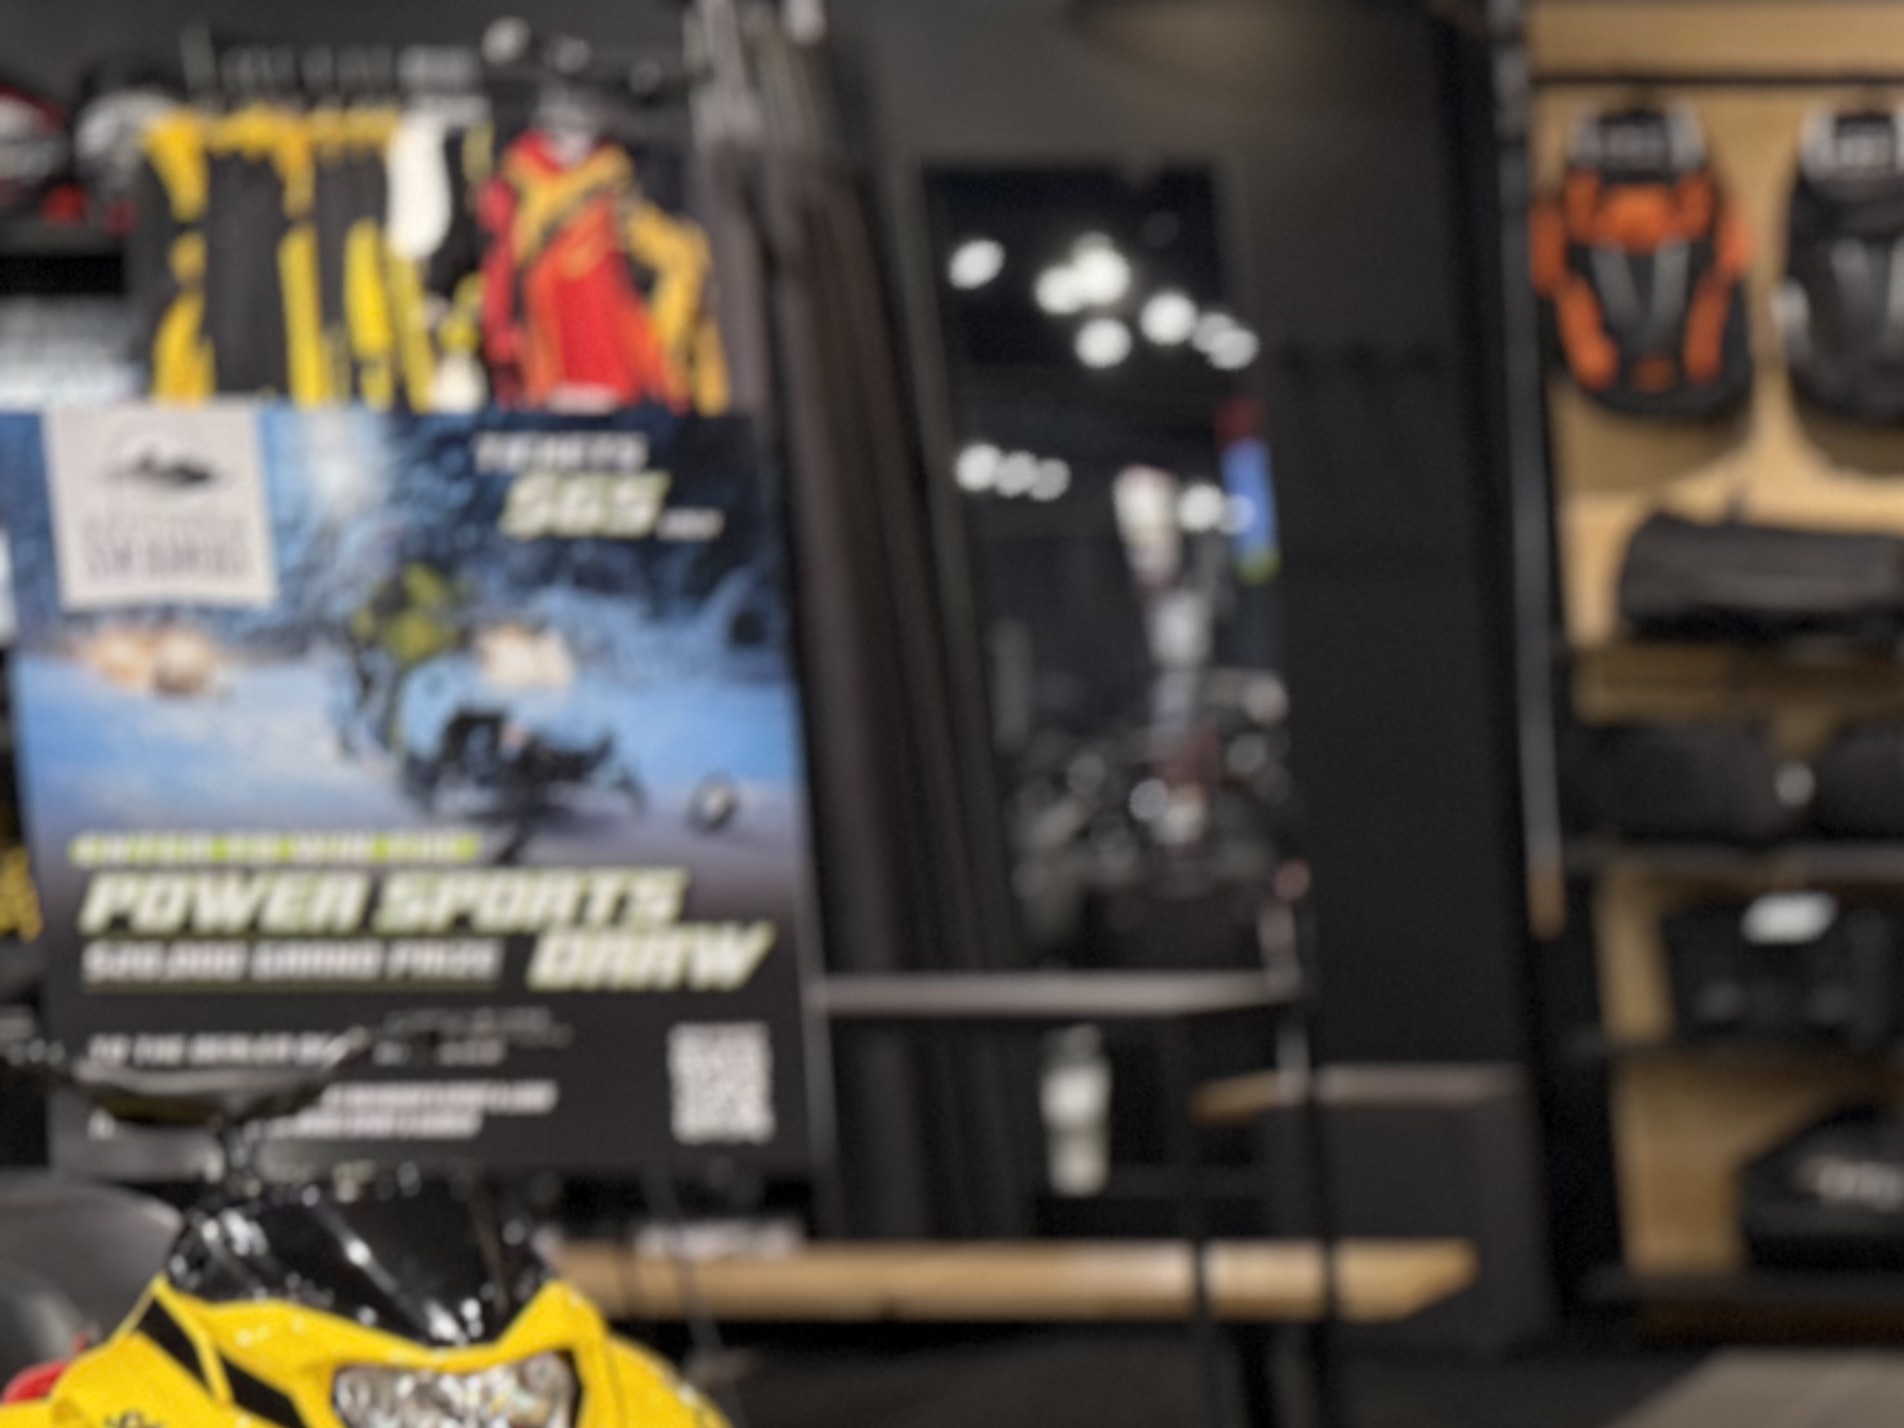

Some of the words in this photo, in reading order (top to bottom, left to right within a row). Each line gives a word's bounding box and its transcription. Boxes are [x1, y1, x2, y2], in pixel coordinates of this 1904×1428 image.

[80, 870, 373, 933] POWER
[373, 869, 689, 933] SPORTS
[528, 922, 775, 989] DRAW
